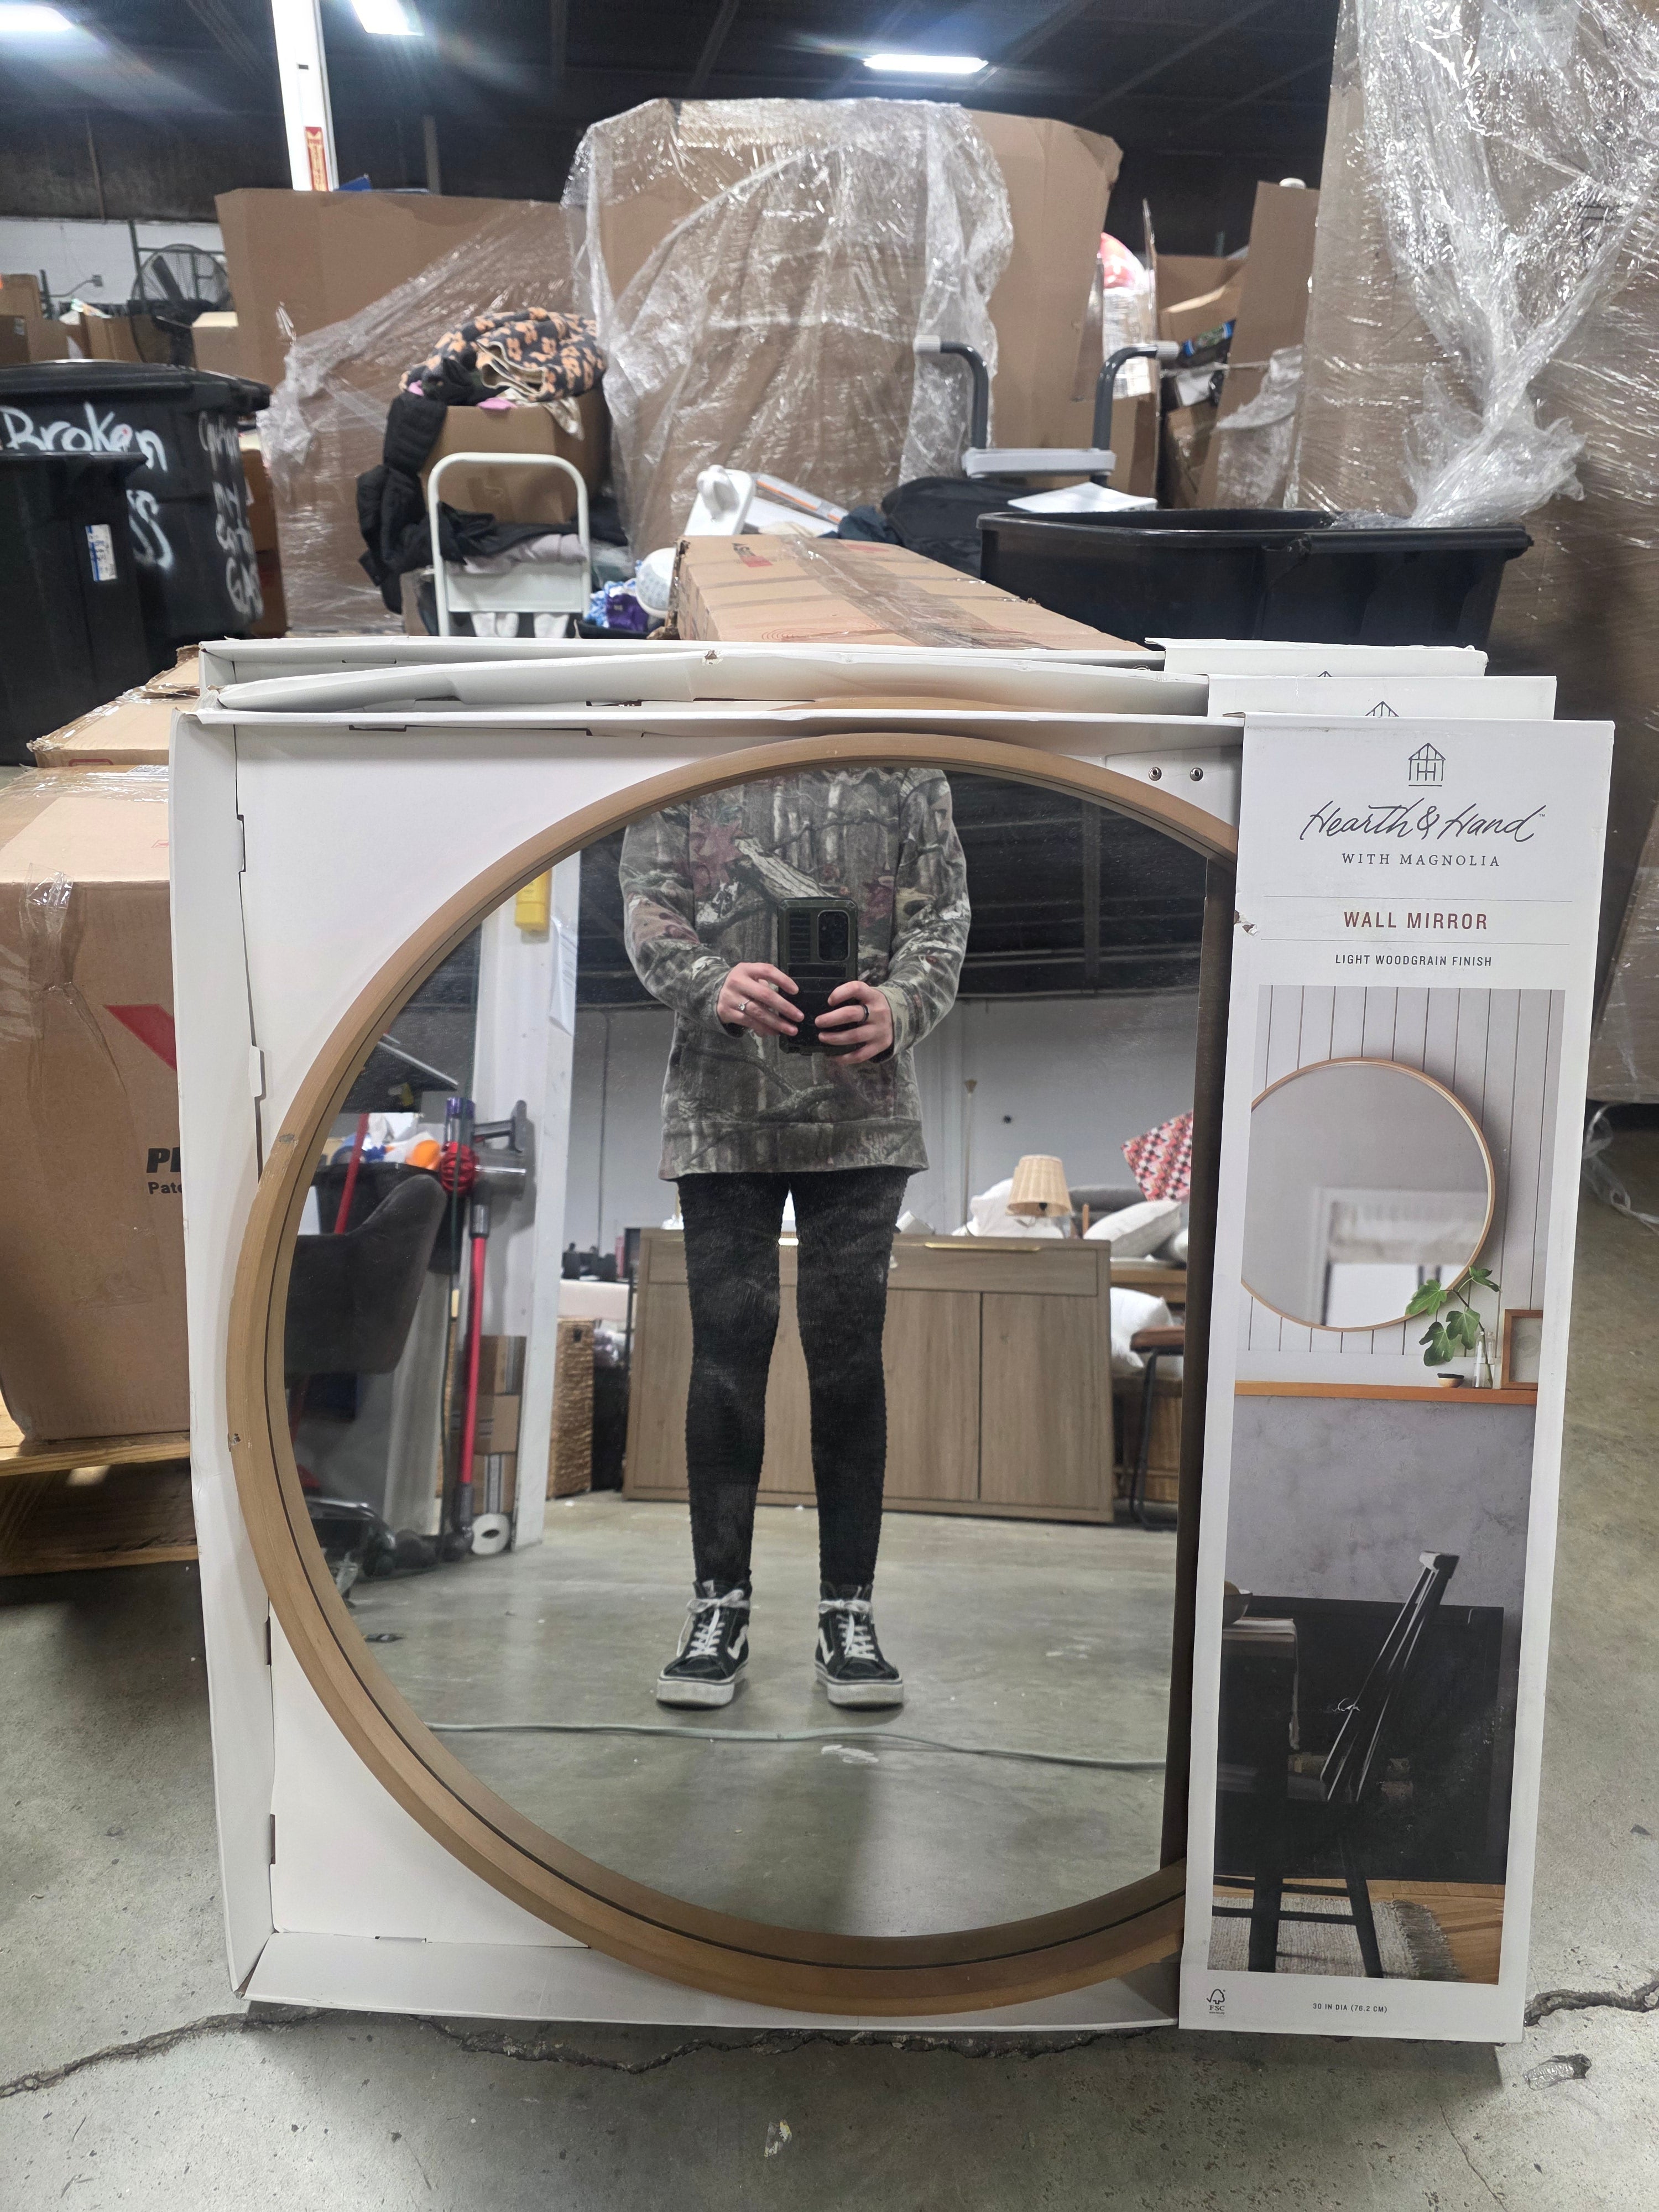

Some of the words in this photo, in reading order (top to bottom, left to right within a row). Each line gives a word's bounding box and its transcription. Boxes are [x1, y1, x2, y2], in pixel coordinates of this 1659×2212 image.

[1300, 797, 1425, 840] Hearth
[1417, 805, 1440, 840] &
[1437, 803, 1546, 842] Hand
[1341, 853, 1390, 864] WITH
[1399, 854, 1500, 867] MAGNOLIA
[1344, 911, 1397, 928] WALL
[1407, 912, 1488, 930] MIRROR
[1335, 954, 1370, 964] LIGHT
[1375, 955, 1447, 966] WOODGRAIN
[1452, 956, 1492, 967] FINISH
